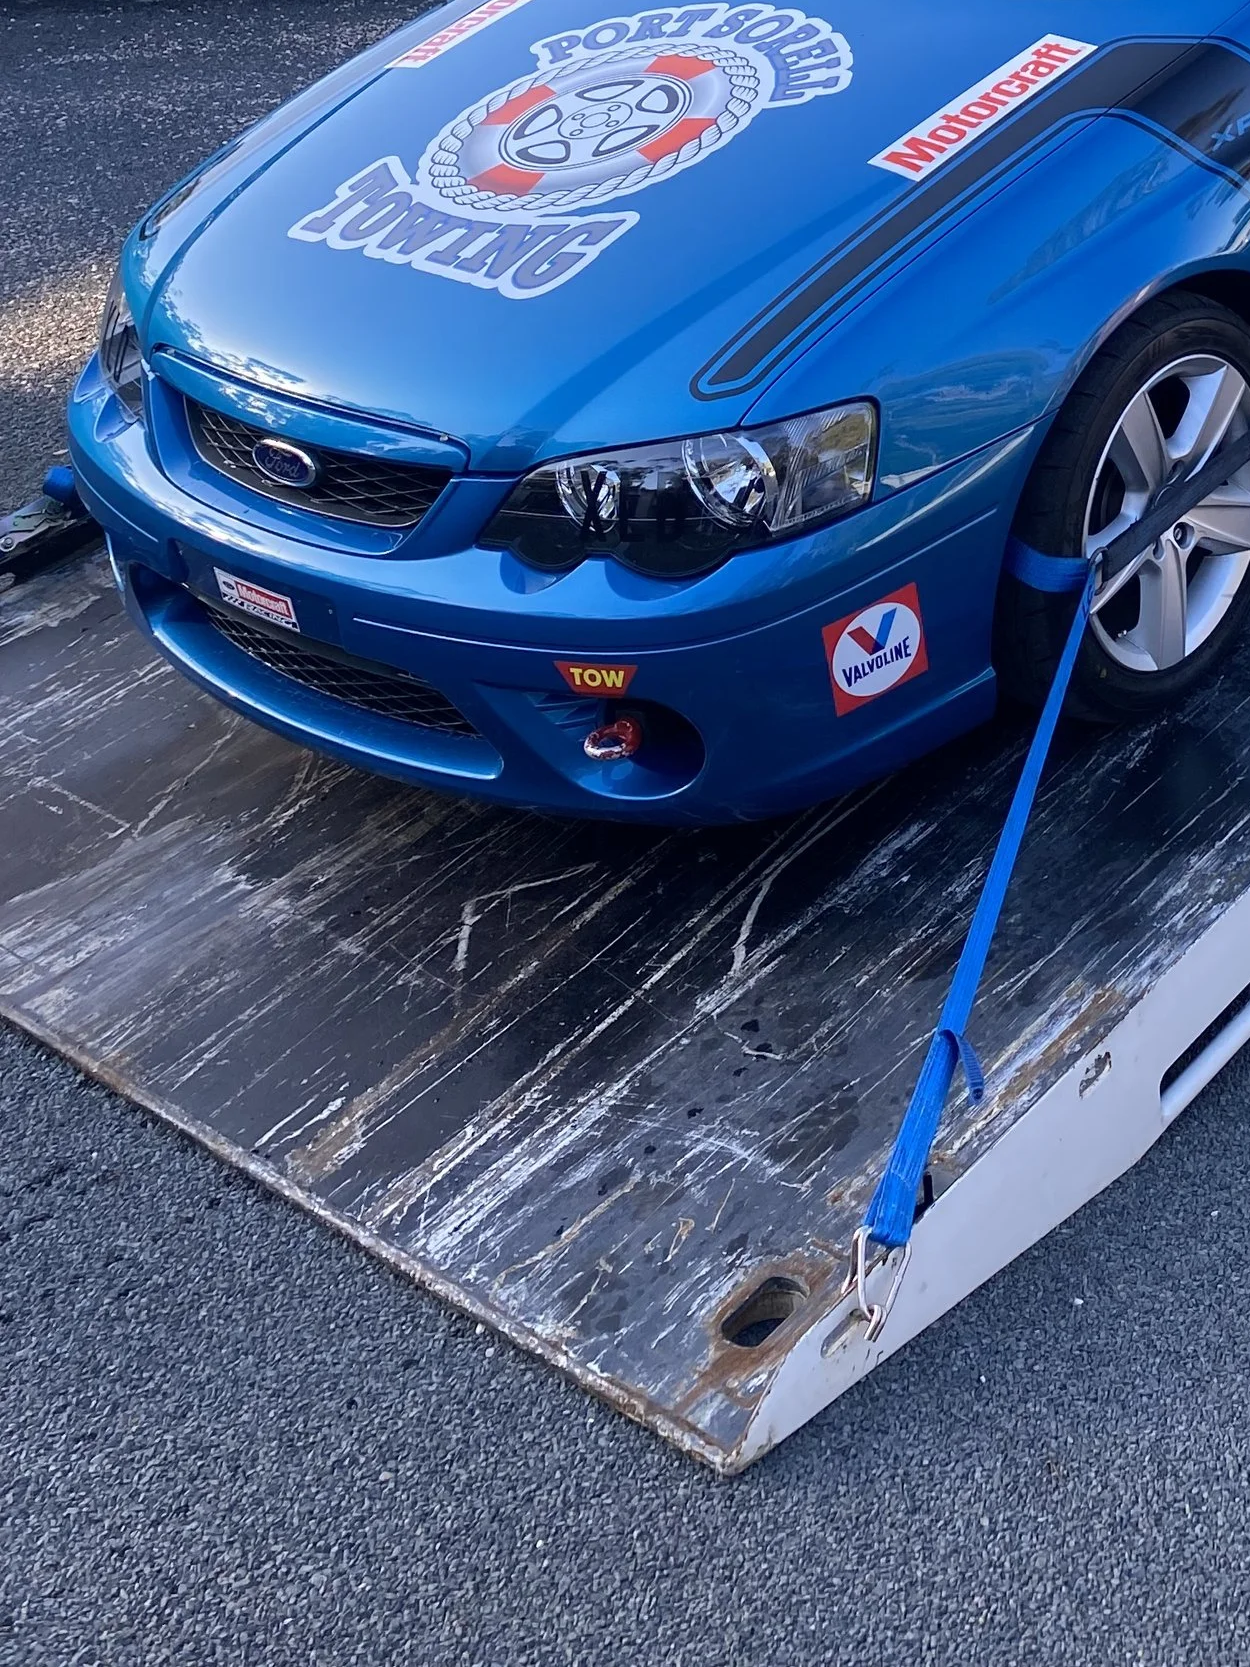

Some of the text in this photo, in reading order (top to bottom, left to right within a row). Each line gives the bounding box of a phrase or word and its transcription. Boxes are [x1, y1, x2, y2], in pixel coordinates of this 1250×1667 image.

[541, 7, 842, 103] PORT SORELL
[882, 42, 1082, 173] Motorcraft
[300, 162, 628, 290] TOWING
[264, 455, 300, 478] Ford
[569, 667, 625, 688] TOW
[842, 635, 912, 688] VALVOLINE
